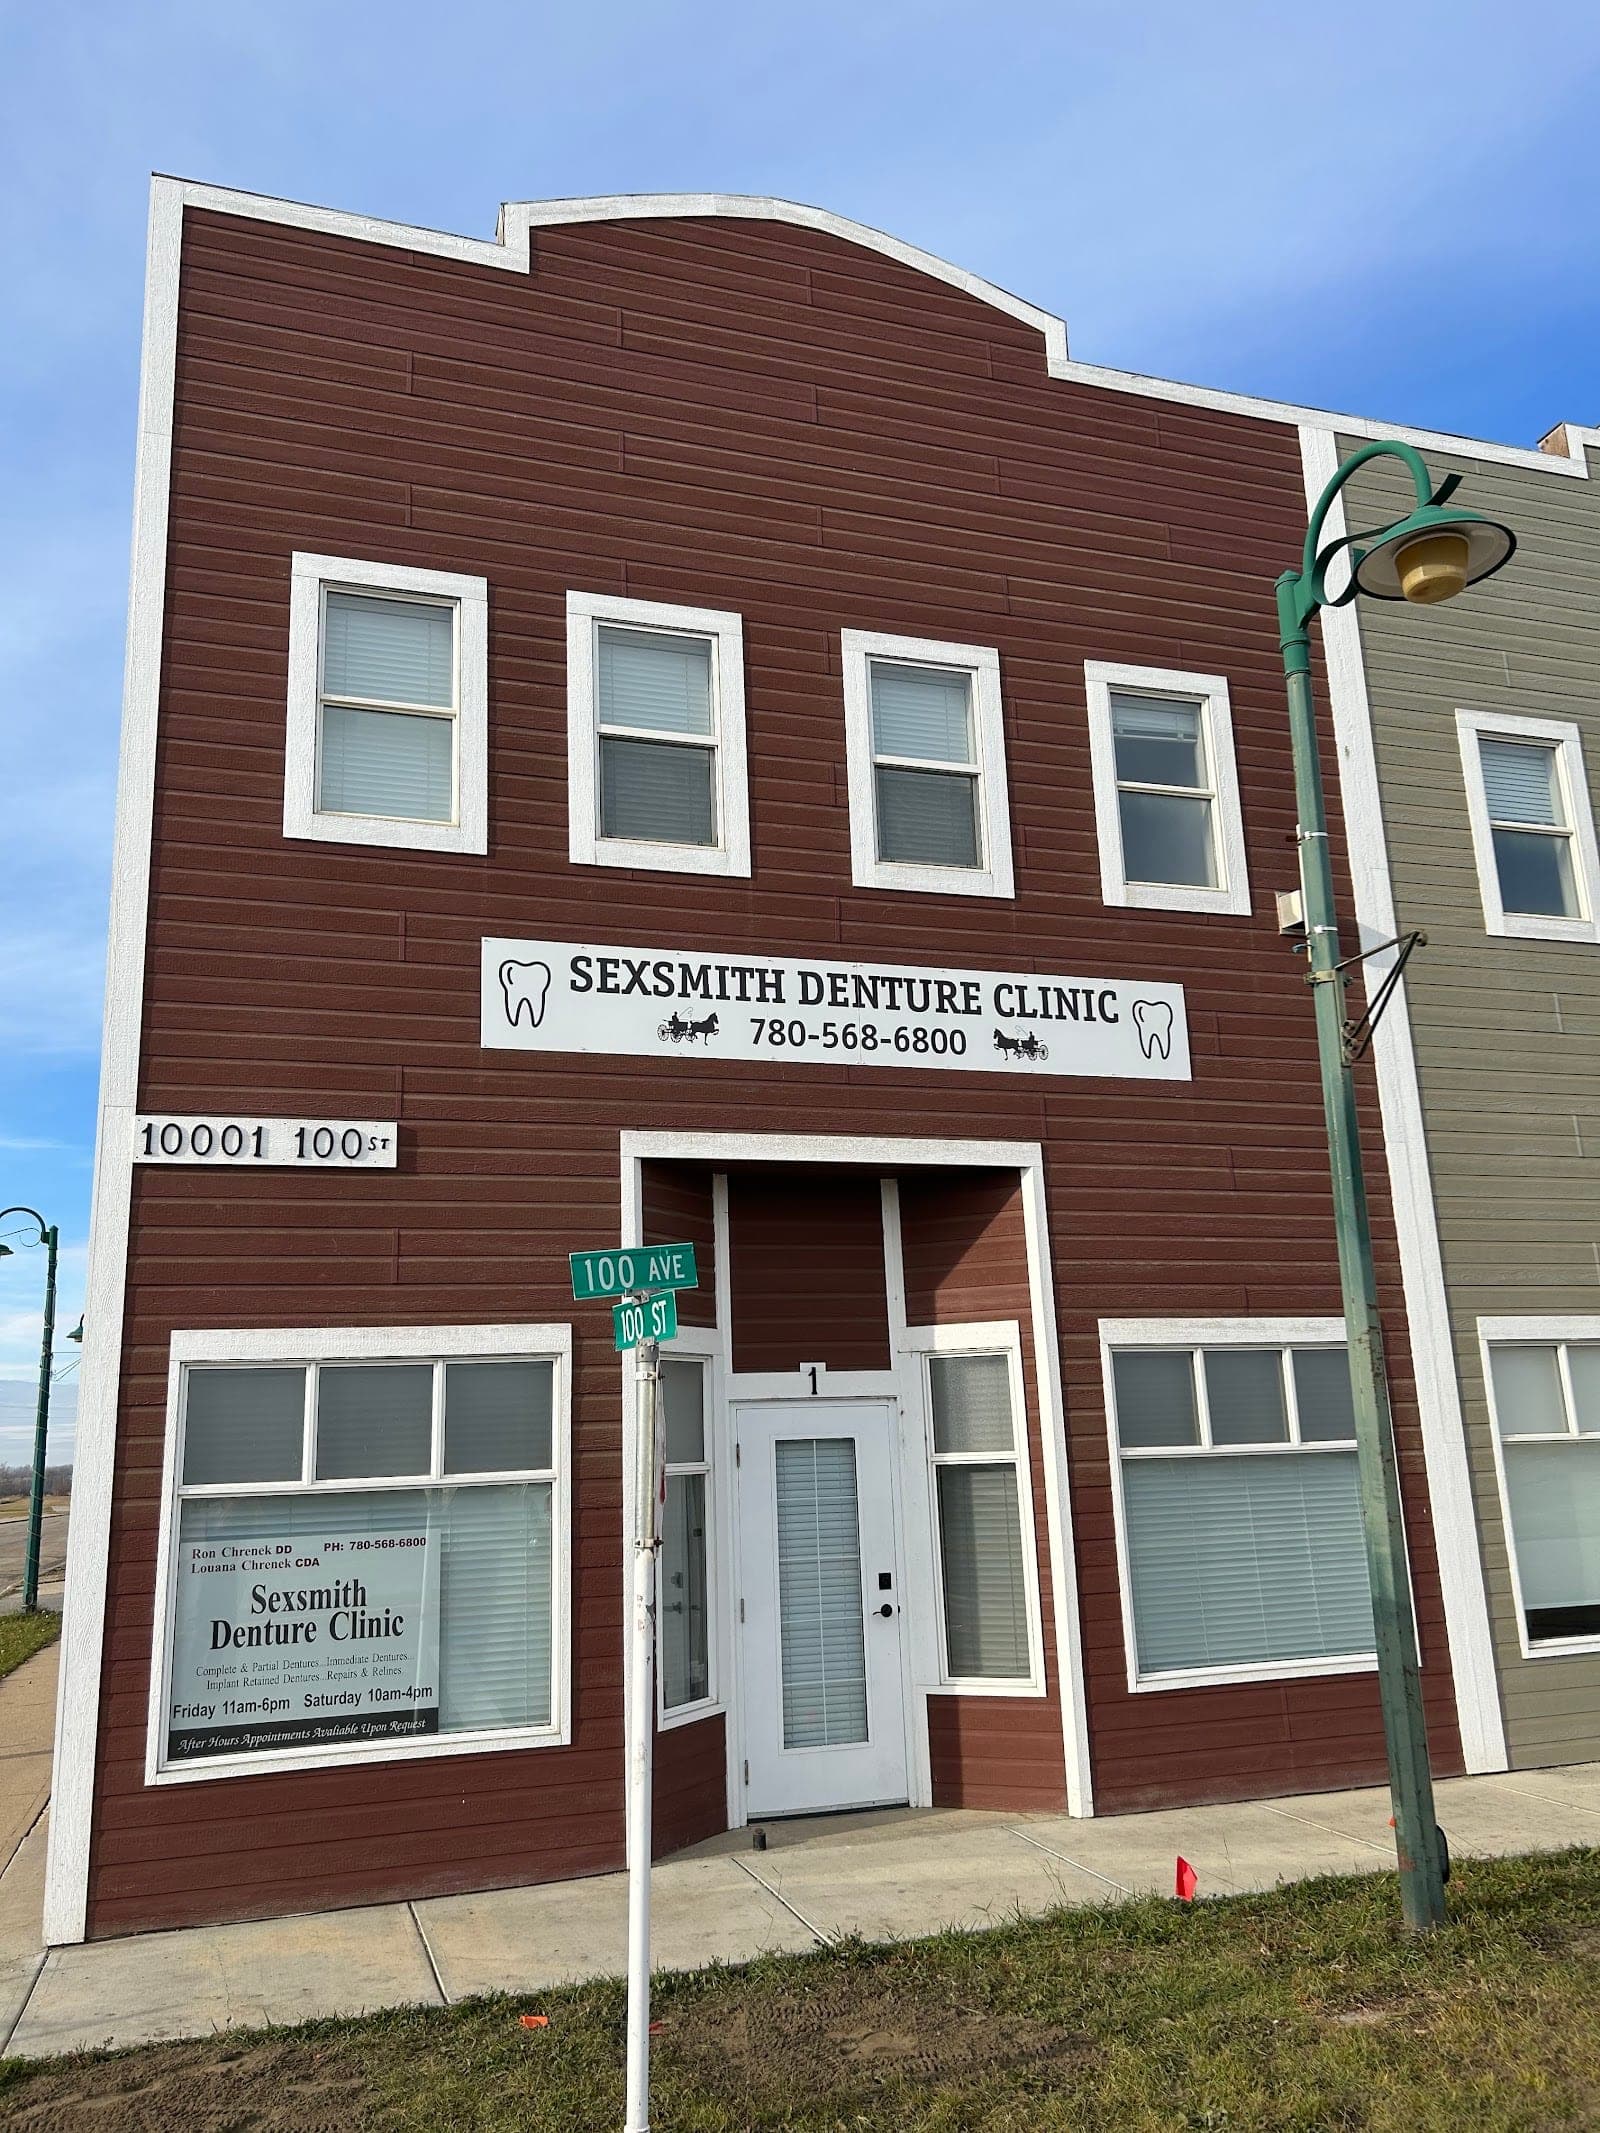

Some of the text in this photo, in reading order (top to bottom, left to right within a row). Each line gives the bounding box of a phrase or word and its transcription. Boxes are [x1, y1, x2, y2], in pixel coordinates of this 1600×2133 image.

[570, 955, 1119, 1023] SEXSMITH DENTURE CLINIC
[750, 1018, 967, 1056] 780-568-6800
[141, 1123, 263, 1158] 10001
[294, 1127, 362, 1159] 100
[584, 1254, 685, 1291] 100 AVE
[620, 1300, 667, 1343] 100 ST
[808, 1366, 818, 1395] 1
[192, 1545, 293, 1559] Ron Chrenek DD
[323, 1537, 427, 1552] PH: 780-568-6800
[191, 1558, 320, 1574] Louana Chrenek CDA
[251, 1579, 367, 1614] Sexsmith
[209, 1608, 404, 1650] Denture Clinic
[196, 1664, 237, 1678] Complete
[240, 1663, 248, 1673] &
[252, 1660, 279, 1672] Partial
[207, 1679, 239, 1692] Implant
[243, 1674, 280, 1687] Retained
[360, 1668, 368, 1678] &
[372, 1666, 402, 1677] Relines
[173, 1685, 433, 1719] Friday 11am-6pm Saturday 10am-4pm
[177, 1737, 207, 1753] After
[208, 1735, 240, 1747] Hours
[240, 1728, 311, 1748] Appointments
[361, 1720, 387, 1737] Upon
[389, 1718, 427, 1734] Request
